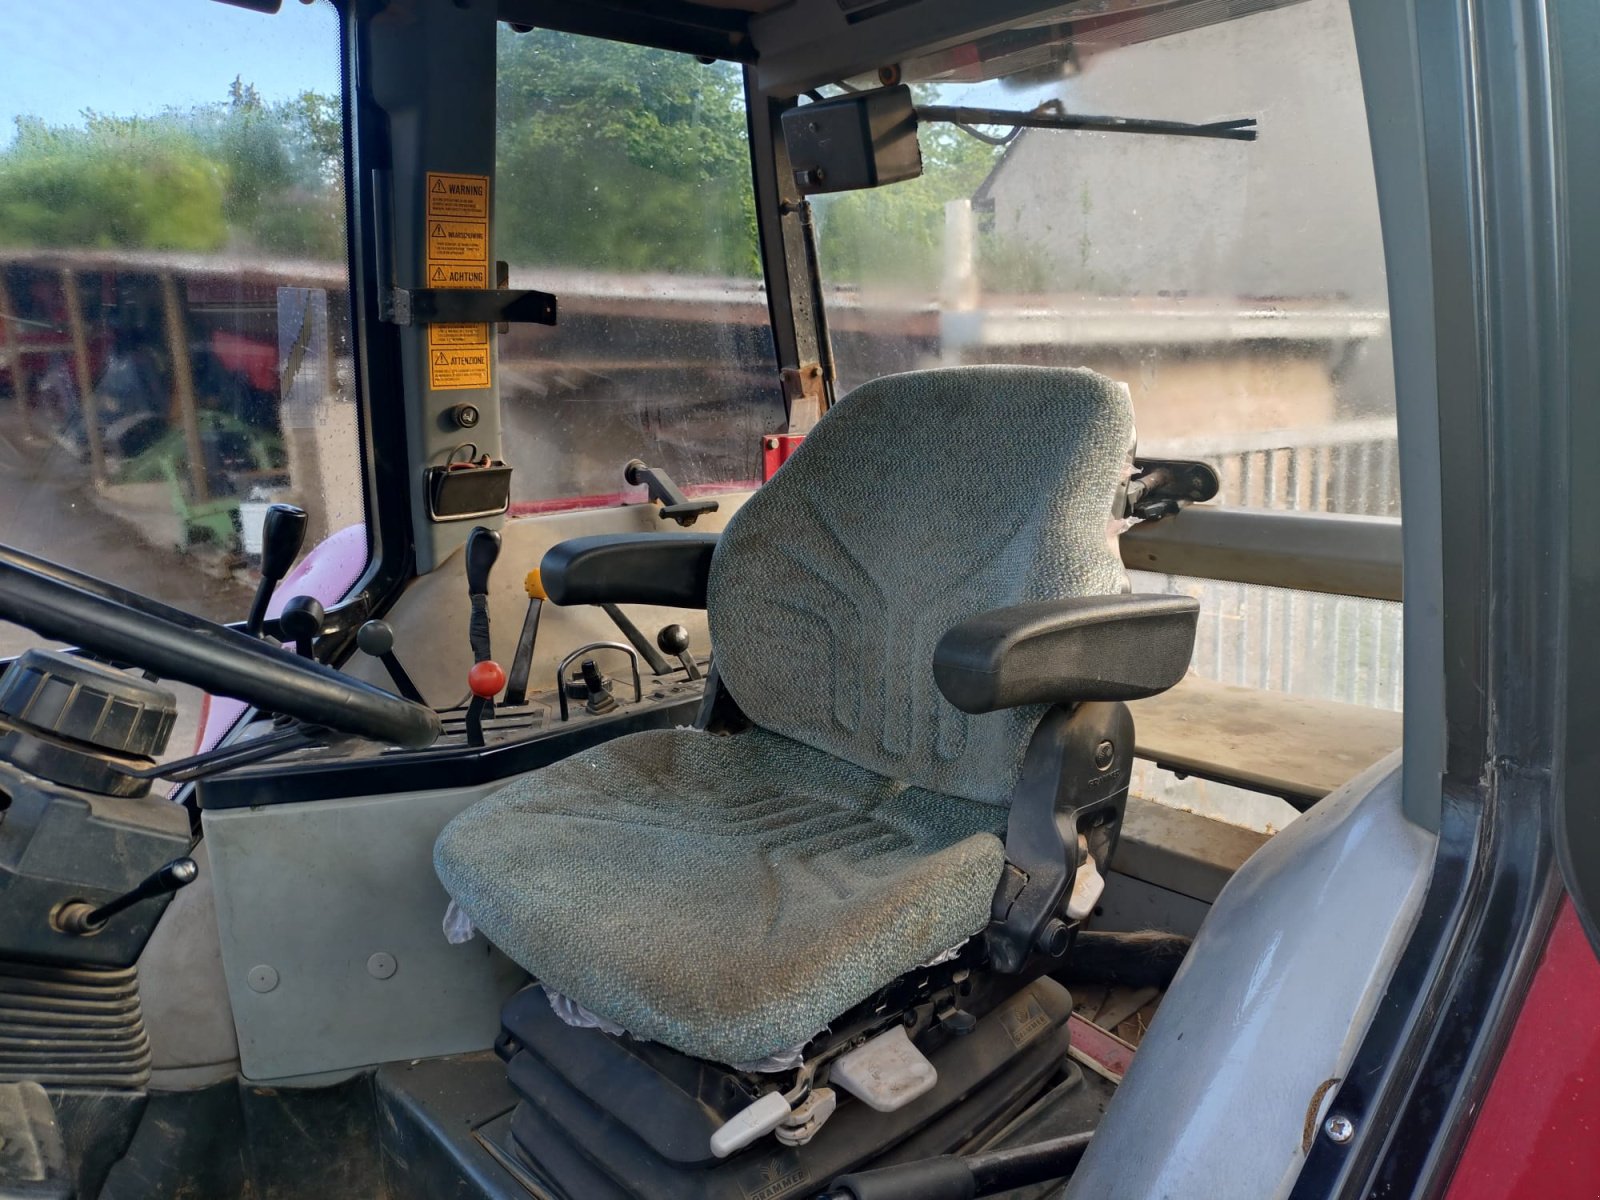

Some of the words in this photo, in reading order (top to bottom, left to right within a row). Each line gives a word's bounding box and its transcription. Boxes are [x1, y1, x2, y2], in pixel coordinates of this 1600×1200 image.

[449, 184, 483, 196] WARNING
[449, 271, 483, 282] ACHTUNG
[450, 356, 485, 366] ATTENZIONE
